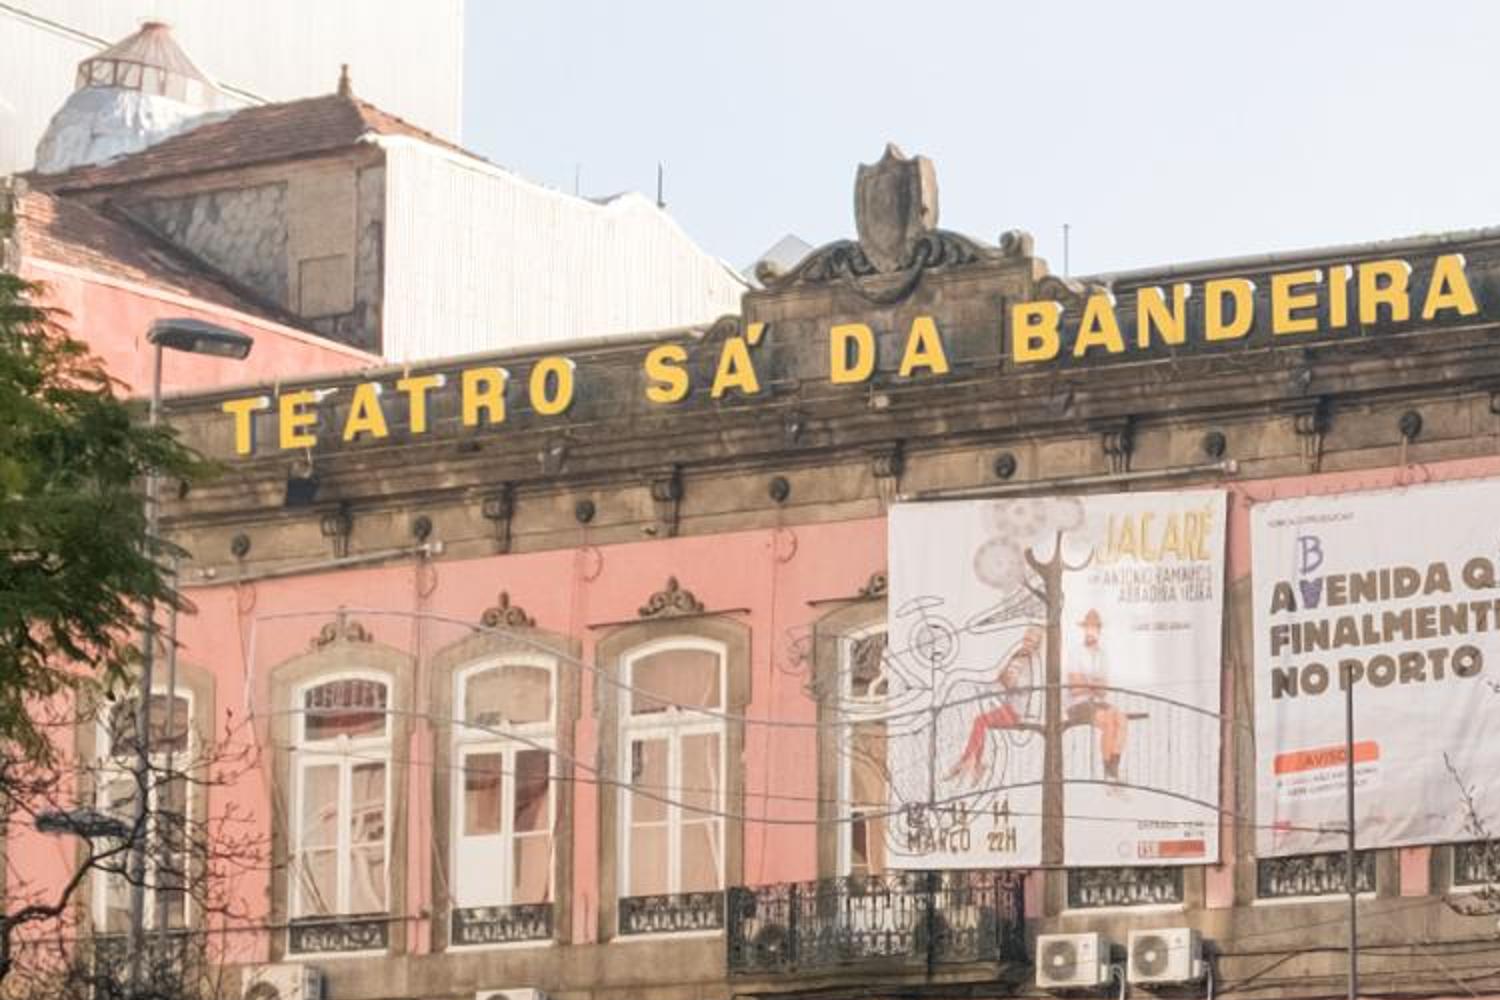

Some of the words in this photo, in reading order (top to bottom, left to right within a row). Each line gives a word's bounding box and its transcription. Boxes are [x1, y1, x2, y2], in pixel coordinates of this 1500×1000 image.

[223, 356, 574, 455] TEATRO
[645, 321, 765, 404] SÁ
[830, 316, 949, 384] DA
[1012, 254, 1479, 363] BANDEIRA
[1097, 500, 1214, 562] JACARÉ
[1270, 562, 1452, 615] AVENIDA
[1462, 557, 1500, 590] Q
[1272, 663, 1328, 699] NO
[1339, 645, 1482, 691] PORTO
[907, 828, 971, 854] MARÇO
